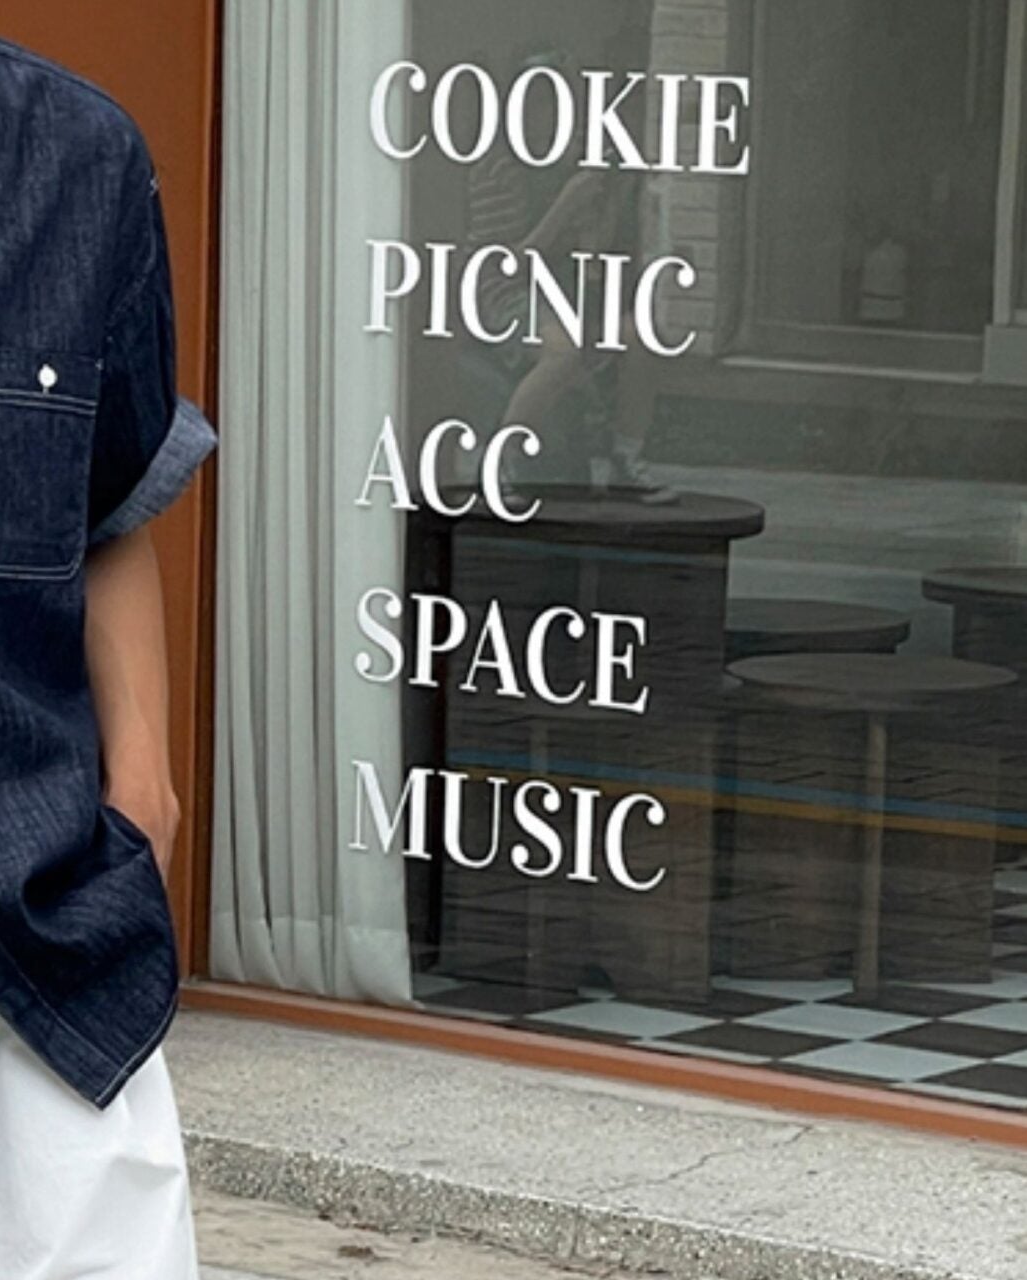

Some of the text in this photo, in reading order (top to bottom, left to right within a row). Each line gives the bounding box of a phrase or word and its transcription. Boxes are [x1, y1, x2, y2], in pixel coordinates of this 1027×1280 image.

[370, 61, 750, 175] COOKIE
[363, 239, 696, 356] PICNIC
[355, 415, 541, 522] ACC
[355, 588, 649, 713] SPACE
[349, 760, 666, 891] MUSIC
